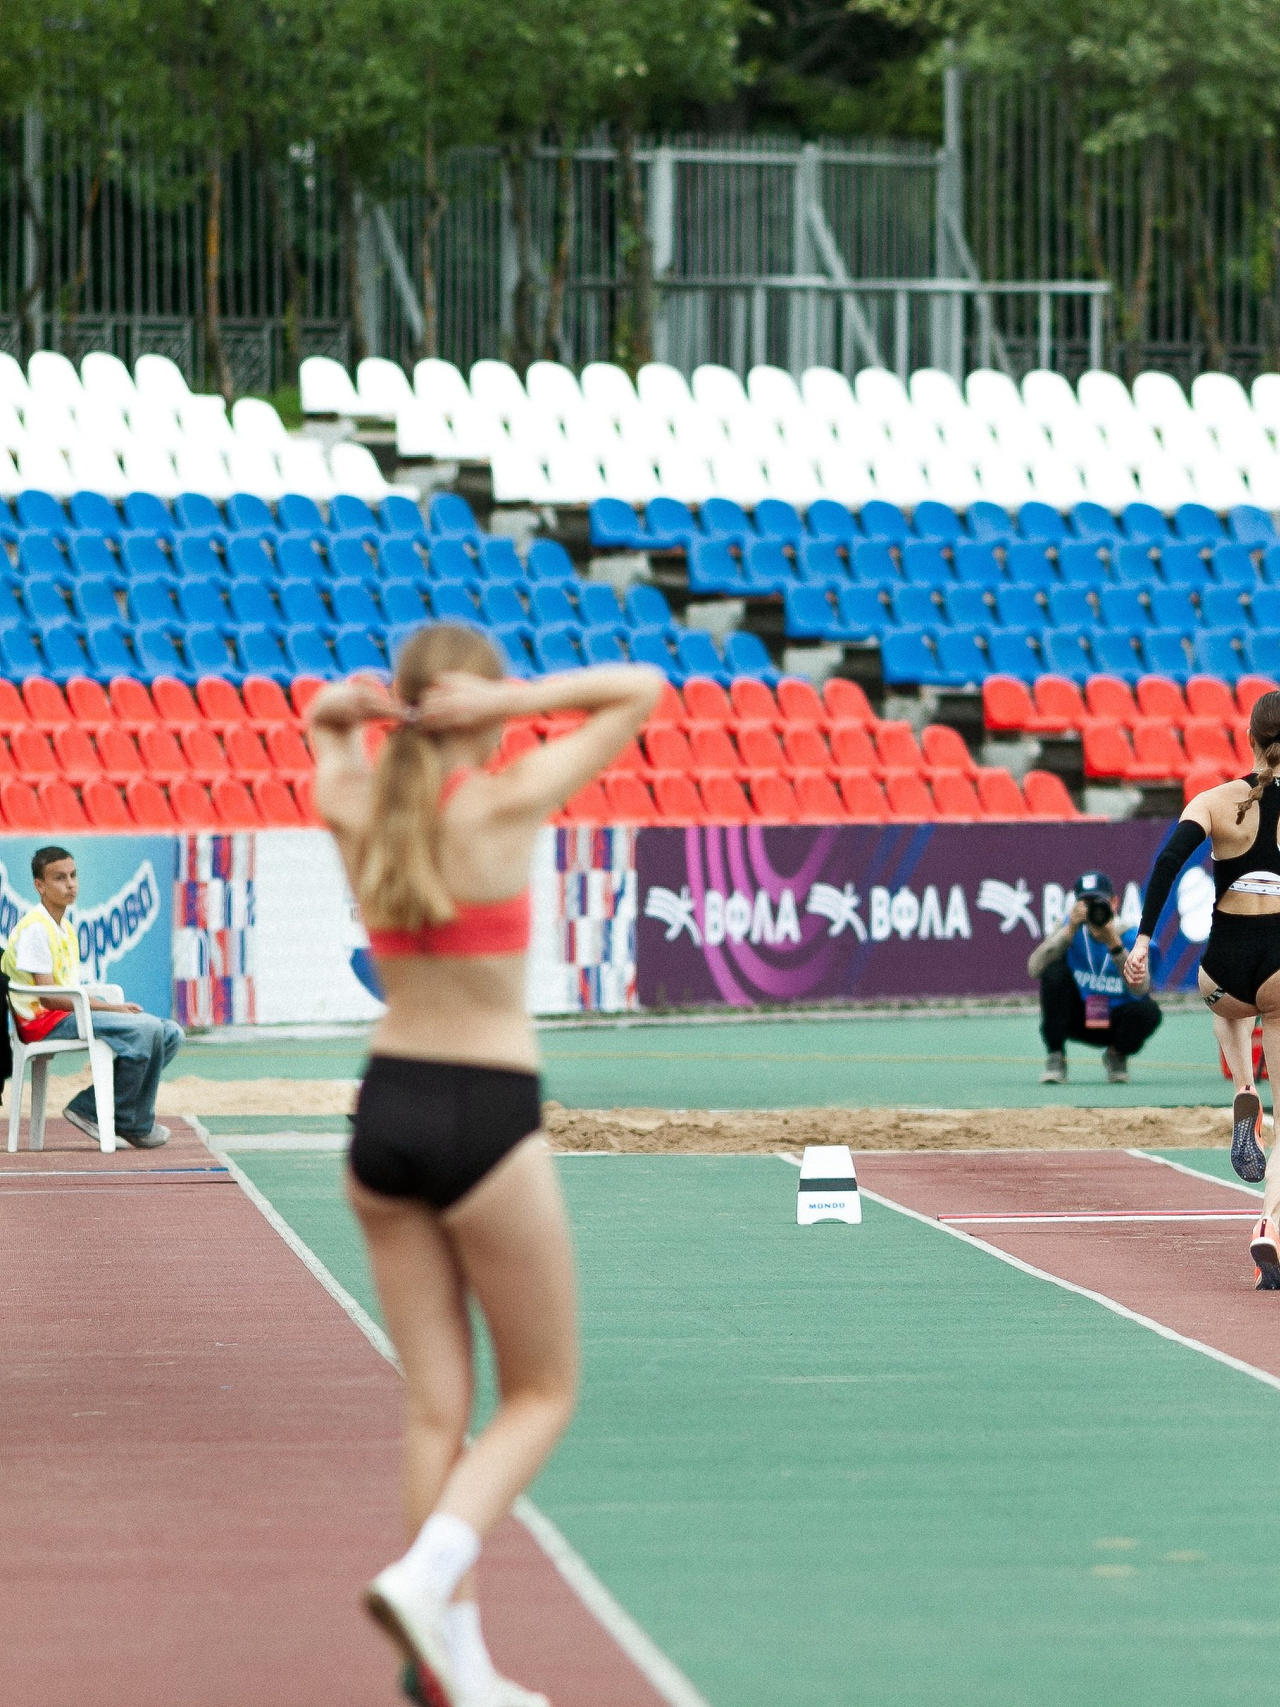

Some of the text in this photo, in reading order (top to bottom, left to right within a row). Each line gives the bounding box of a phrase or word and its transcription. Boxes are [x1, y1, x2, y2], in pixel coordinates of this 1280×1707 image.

[704, 887, 802, 945] ВФЛА
[870, 883, 972, 941] ВФЛА
[808, 1202, 846, 1210] MONDO
